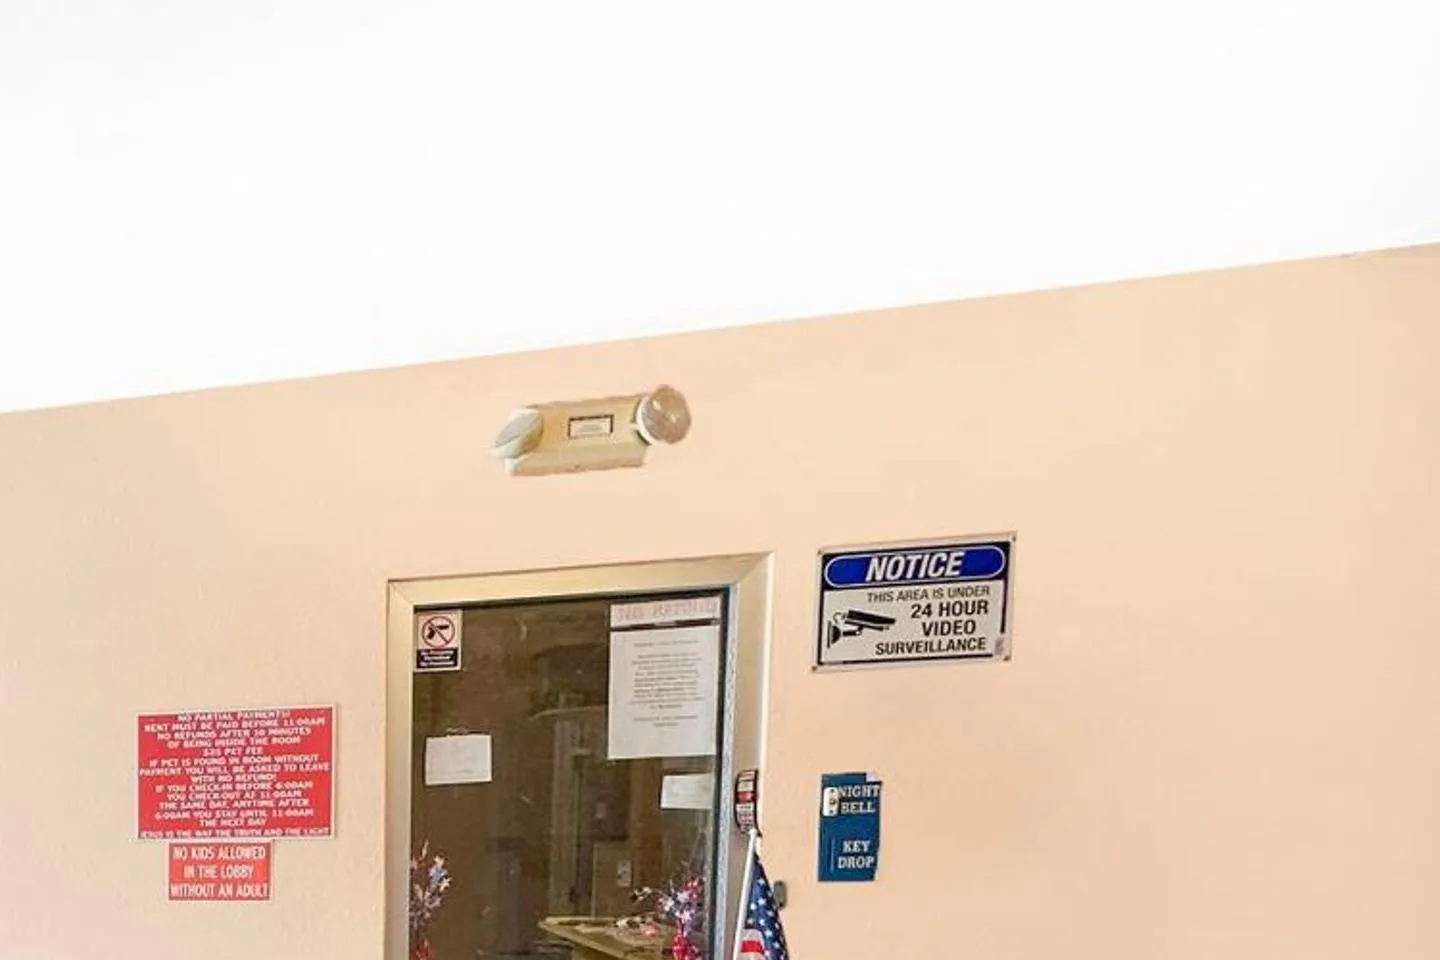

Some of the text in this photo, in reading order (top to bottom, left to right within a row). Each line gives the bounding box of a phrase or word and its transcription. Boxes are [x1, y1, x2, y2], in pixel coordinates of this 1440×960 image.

[865, 552, 965, 582] NOTICE
[867, 586, 990, 603] THIS AREA IS UNDER
[911, 600, 989, 619] 24 HOUR
[922, 620, 976, 637] VIDEO
[875, 637, 987, 655] SURVEILLANCE
[177, 714, 192, 722] NO
[194, 712, 234, 721] PARTIAL
[144, 723, 169, 733] RENT
[171, 722, 197, 731] MUST
[200, 722, 213, 730] BE
[215, 721, 239, 729] PAID
[241, 719, 278, 728] BEFORE
[157, 733, 172, 741] NO
[174, 731, 217, 740] REFUNDS
[219, 729, 251, 738] AFTER
[268, 726, 312, 736] MINUTES
[166, 736, 301, 749] OF BEING INSIDE THE ROOM
[224, 747, 243, 756] PET
[245, 746, 264, 755] FEE
[149, 753, 320, 767] IF PET IS FOUND IN ROOM WITHOUT
[140, 767, 182, 777] PAYMENT
[185, 767, 204, 775] YOU
[205, 766, 229, 774] WILL
[232, 765, 245, 773] BE
[248, 763, 281, 772] ASKED
[284, 763, 297, 771] TO
[191, 774, 215, 783] WITH
[217, 774, 233, 782] NO
[155, 784, 164, 793] IF
[167, 784, 187, 793] YOU
[235, 782, 272, 791] BEFORE
[838, 784, 880, 797] NIGHT
[167, 793, 187, 801] YOU
[243, 791, 256, 799] AT
[160, 802, 177, 810] THE
[180, 801, 205, 809] SAME
[233, 799, 274, 808] ANYTIME
[278, 798, 310, 807] AFTER
[840, 802, 876, 814] BELL
[192, 810, 212, 818] YOU
[215, 809, 237, 818] STAY
[239, 809, 267, 818] UNTIL
[200, 817, 267, 827] THE NEXT DAY
[173, 846, 266, 860] NO KIDS ALLOWED
[842, 840, 871, 853] KEY
[838, 856, 874, 869] DROP
[184, 864, 254, 878] IN THE LOBBY
[170, 883, 267, 897] WITHOUT AN ADULT
